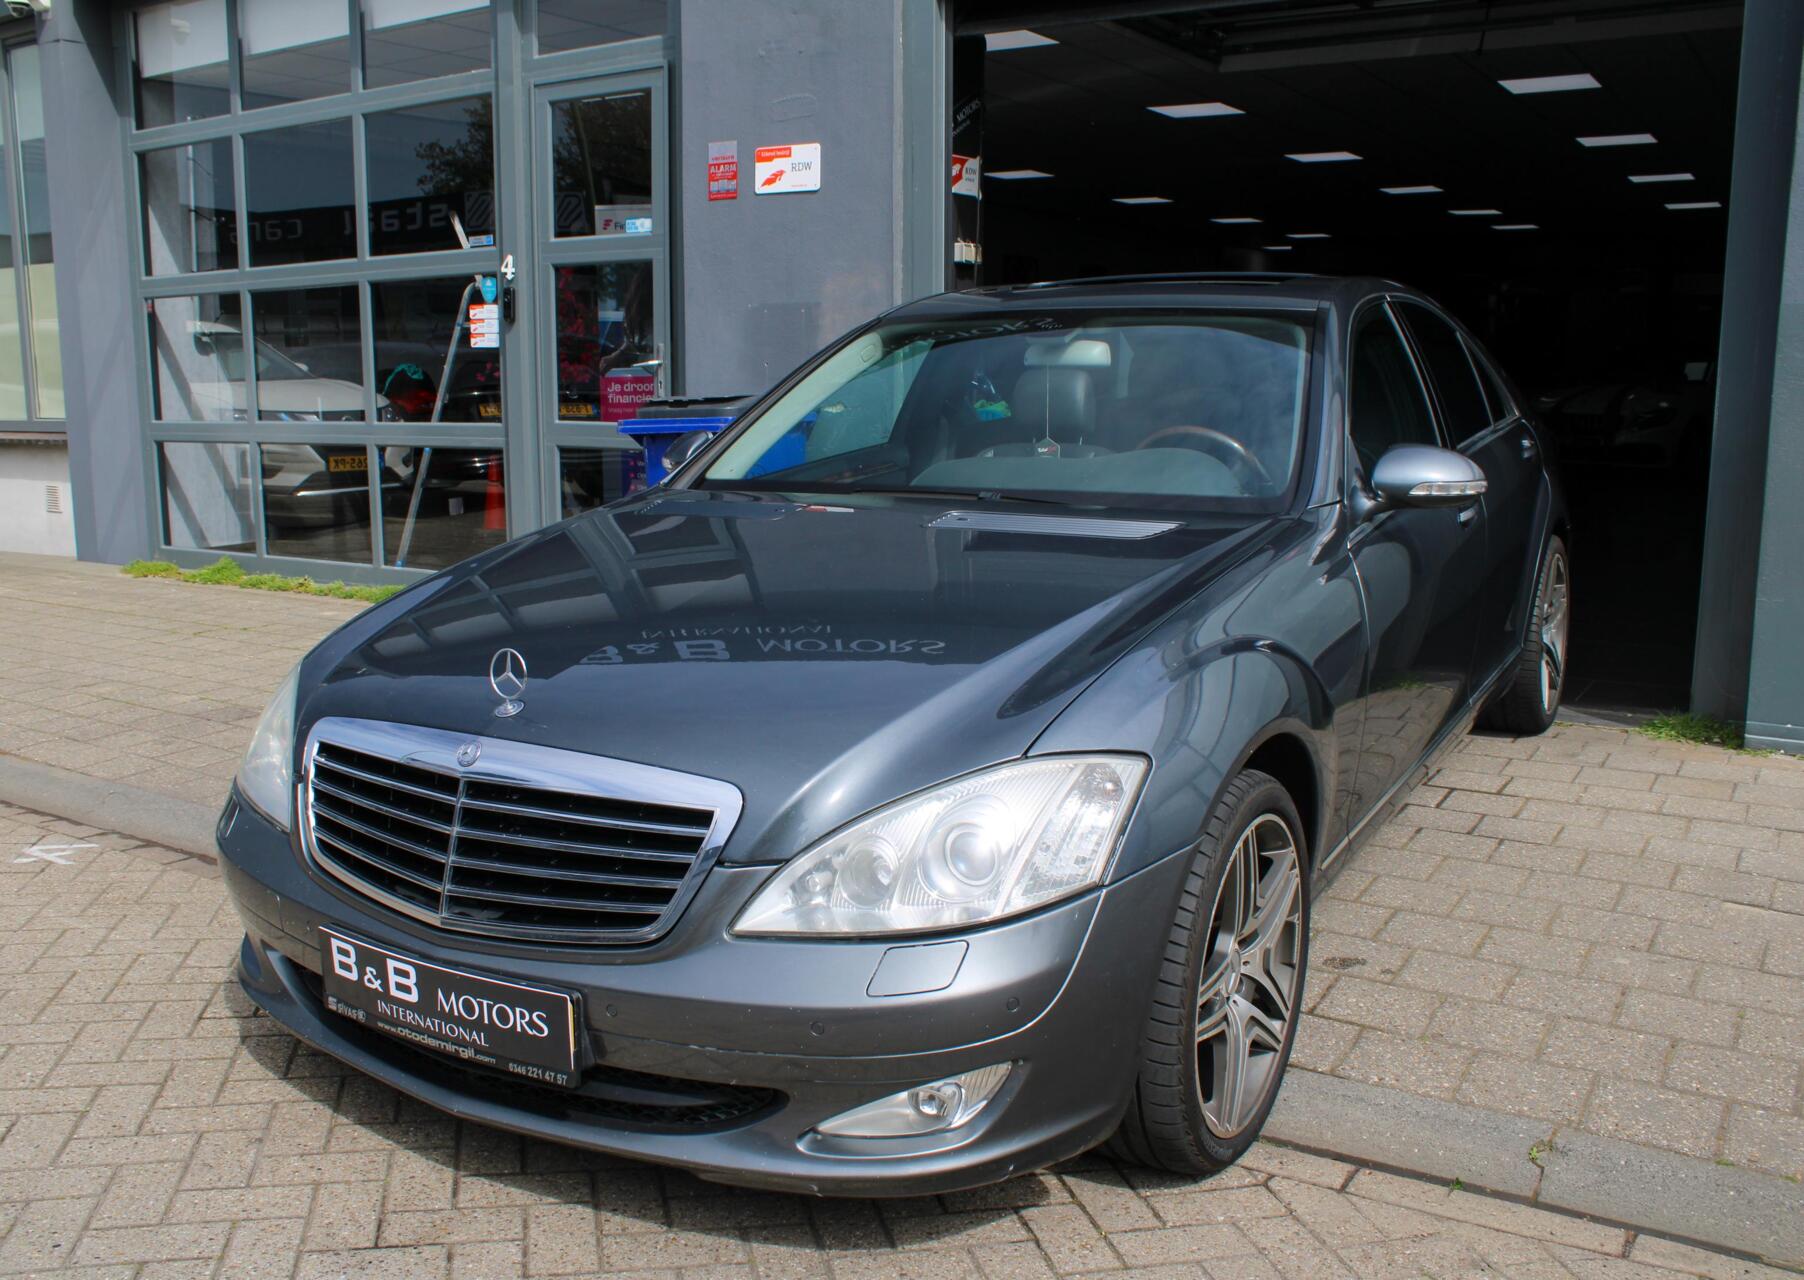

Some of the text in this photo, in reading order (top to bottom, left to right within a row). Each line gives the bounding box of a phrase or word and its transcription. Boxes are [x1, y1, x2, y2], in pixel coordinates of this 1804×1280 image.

[710, 163, 736, 174] ALARM
[791, 161, 812, 172] RDW
[501, 254, 516, 281] 4
[607, 382, 622, 392] Je
[331, 937, 549, 1037] B & B MOTORS
[377, 1000, 489, 1047] INTERNATIONAL
[377, 1021, 496, 1065] www.otodemirgil.com
[527, 1066, 543, 1080] 221
